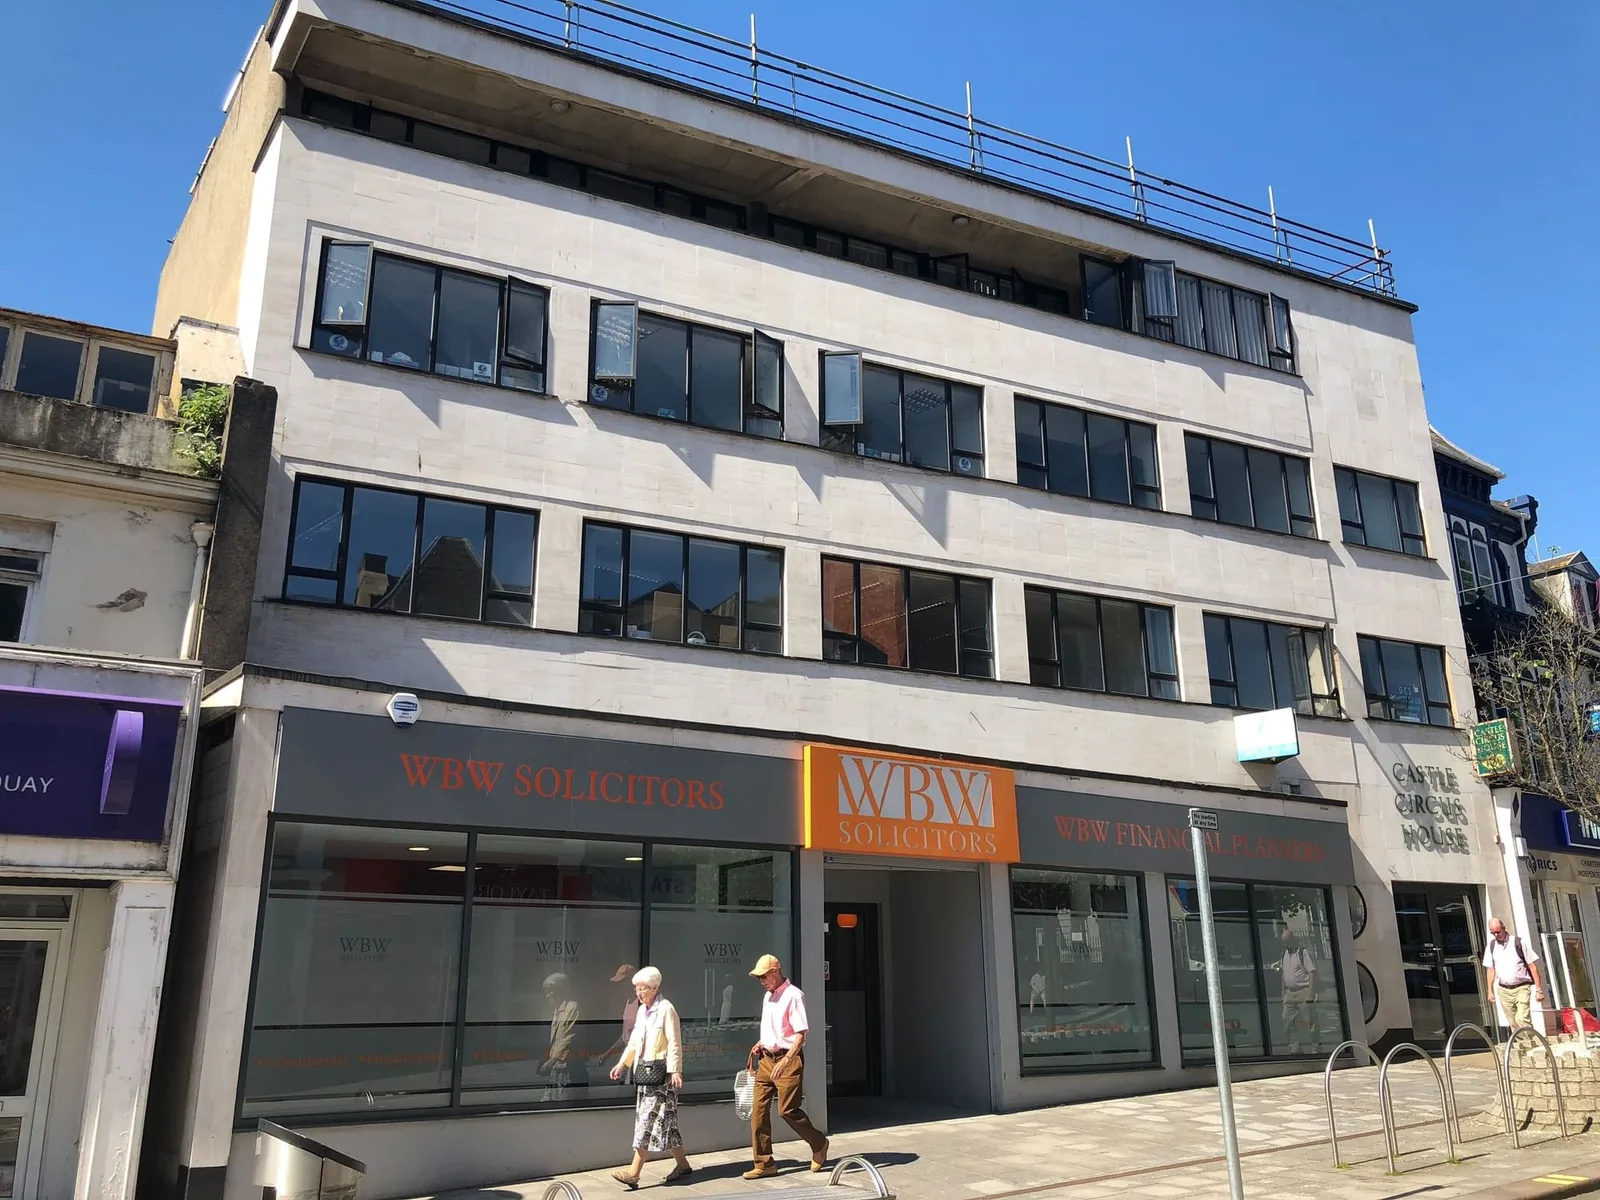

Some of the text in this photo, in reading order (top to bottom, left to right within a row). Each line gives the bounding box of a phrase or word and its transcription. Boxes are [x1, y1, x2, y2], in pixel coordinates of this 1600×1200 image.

[0, 774, 54, 793] UAY
[400, 753, 725, 810] WBW SOLICITORS
[1392, 762, 1453, 787] CASTLE
[838, 754, 994, 828] WBW
[1394, 793, 1461, 816] CIRCUS
[839, 820, 997, 855] SOLICITORS
[1054, 815, 1110, 844] WBW
[1116, 822, 1228, 855] FINANCAL
[1401, 824, 1464, 847] HOUSE
[1537, 858, 1558, 871] RICS
[339, 936, 392, 953] WBW
[536, 940, 580, 955] WBW
[703, 943, 742, 956] WBW
